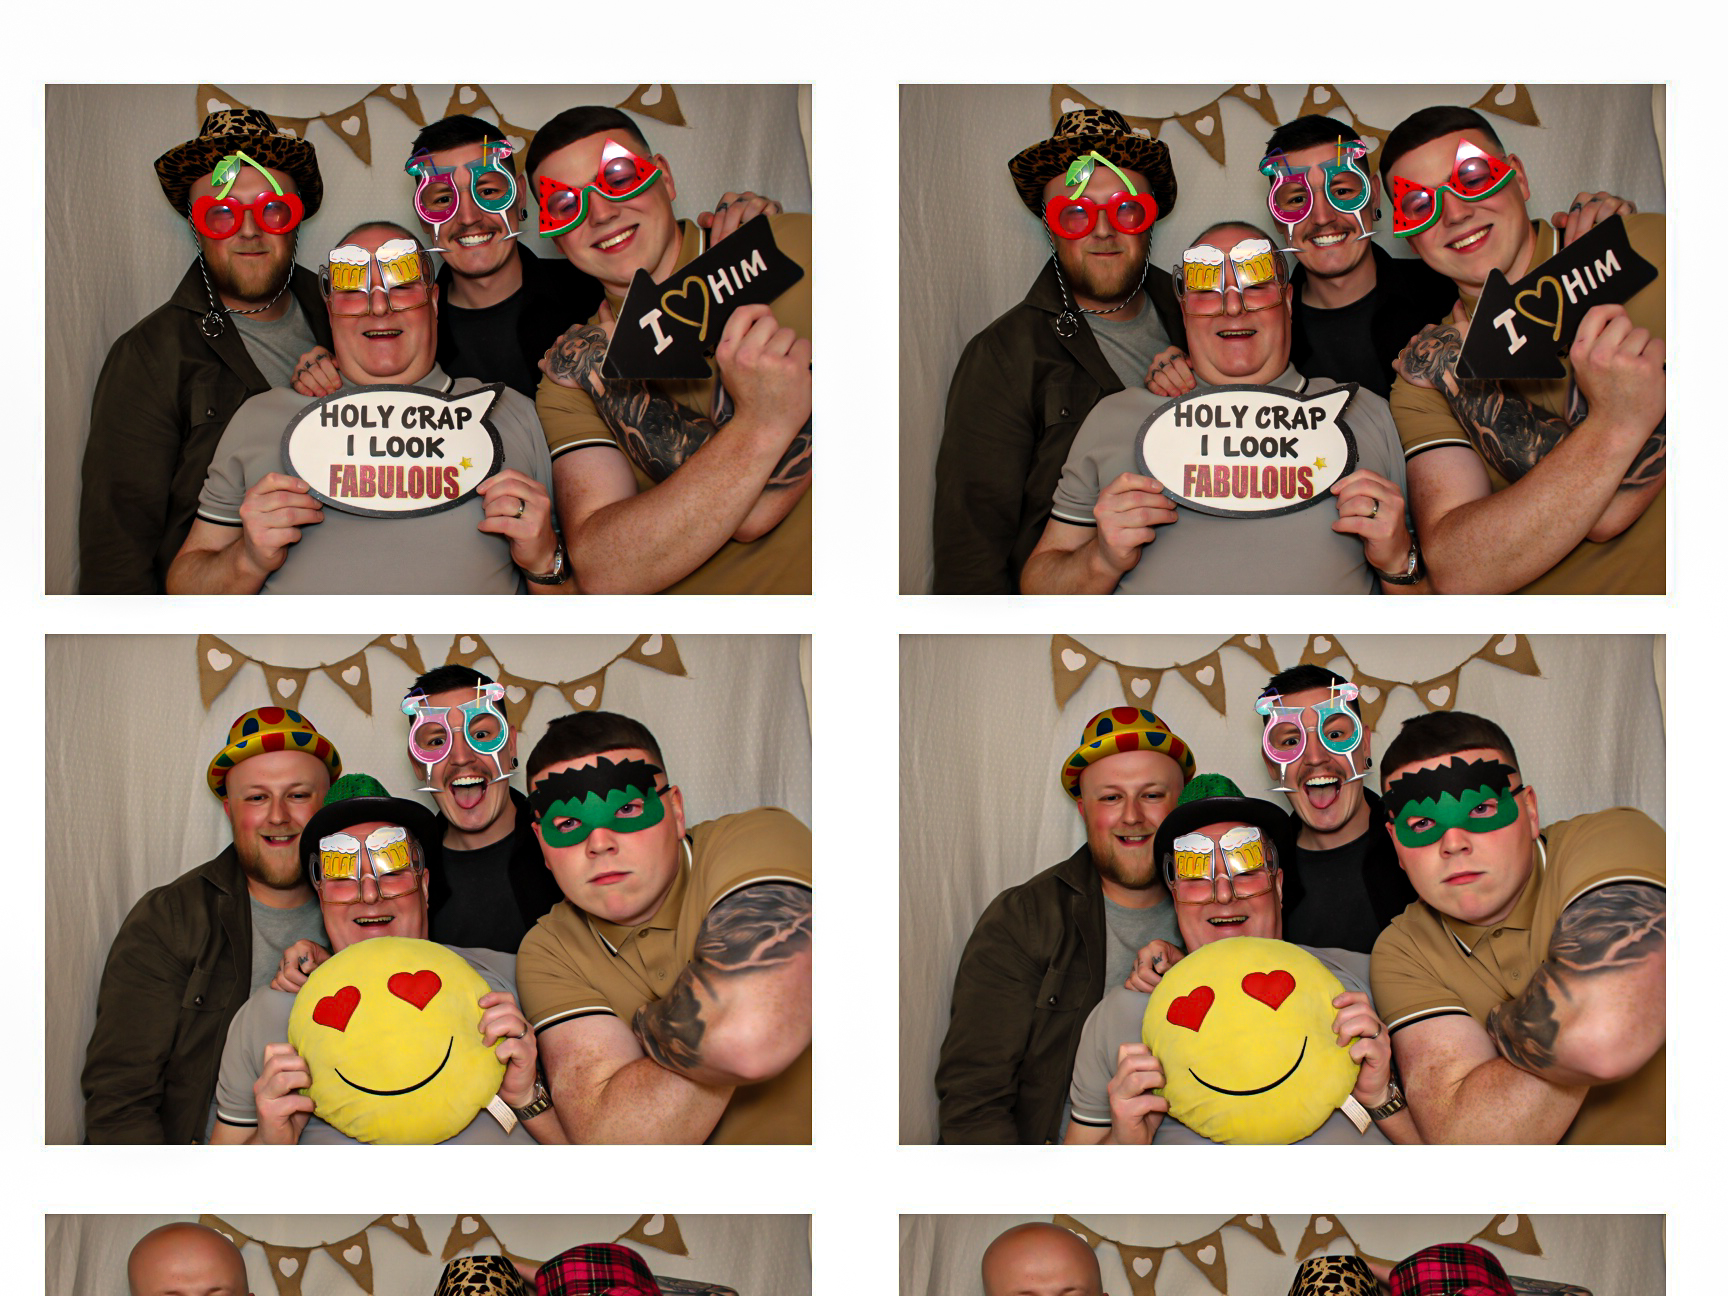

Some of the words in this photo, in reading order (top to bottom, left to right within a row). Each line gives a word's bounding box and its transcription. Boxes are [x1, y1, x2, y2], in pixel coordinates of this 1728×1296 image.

[639, 308, 673, 355] I
[707, 249, 768, 304] HIM
[1493, 308, 1527, 355] I
[1561, 249, 1622, 304] HIM
[320, 403, 395, 428] HOLY
[401, 405, 473, 431] CRAP
[1174, 403, 1249, 428] HOLY
[1255, 405, 1327, 431] CRAP
[346, 434, 355, 456] I
[369, 436, 445, 459] LOOK
[1200, 434, 1209, 456] I
[1223, 436, 1299, 459] LOOK
[329, 464, 460, 500] FABULOUS
[1183, 464, 1314, 500] FABULOUS
